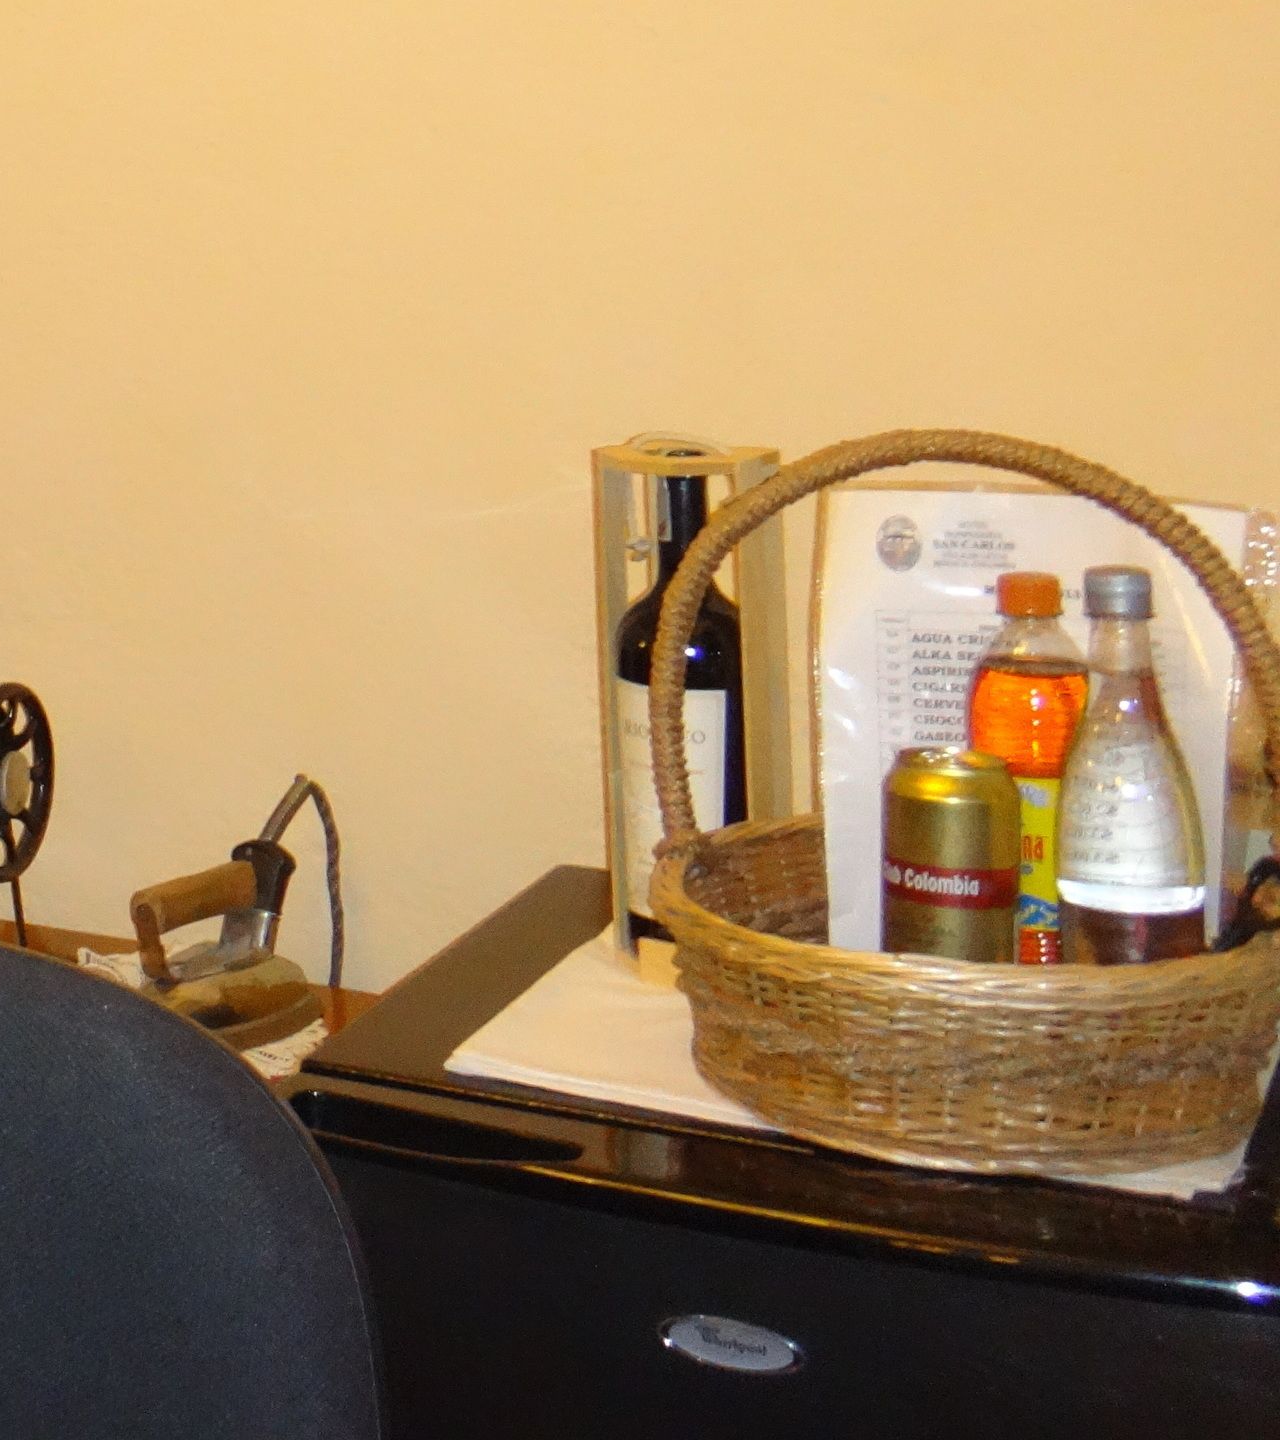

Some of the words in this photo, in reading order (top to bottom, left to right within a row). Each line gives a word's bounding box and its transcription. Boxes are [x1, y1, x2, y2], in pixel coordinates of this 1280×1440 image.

[912, 697, 965, 710] CERVE
[914, 730, 966, 743] GASEO
[904, 868, 980, 896] Colombia
